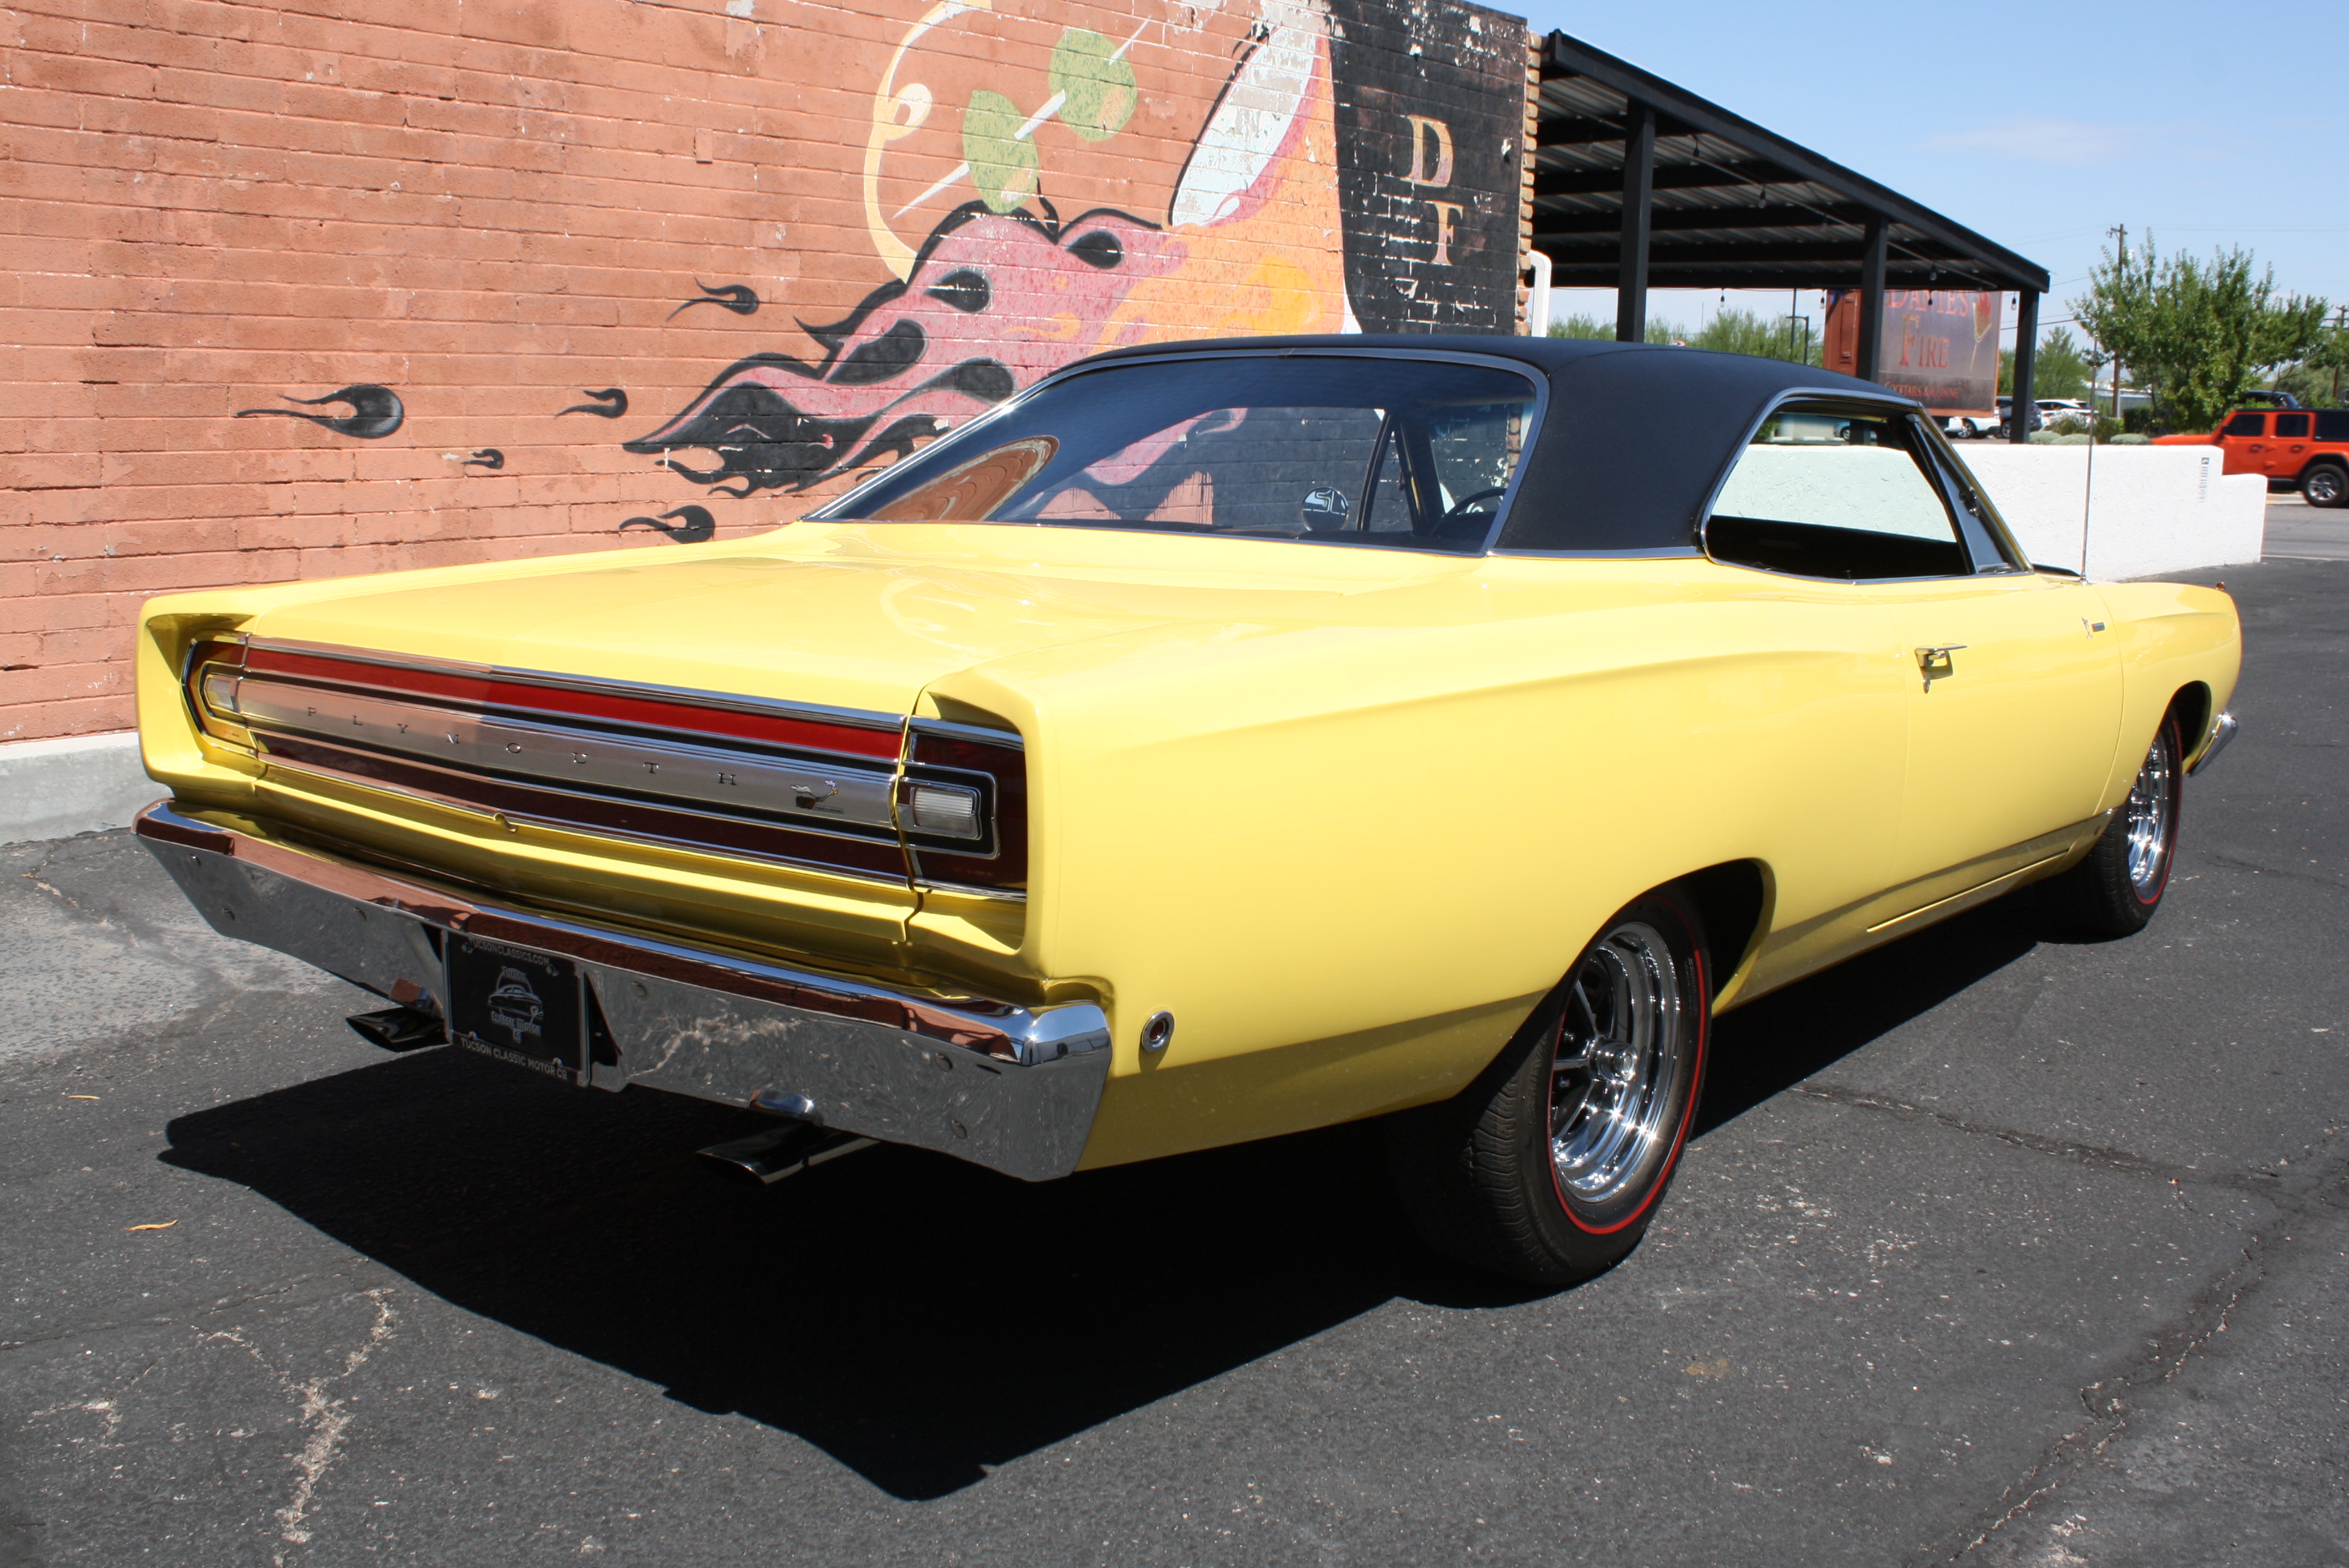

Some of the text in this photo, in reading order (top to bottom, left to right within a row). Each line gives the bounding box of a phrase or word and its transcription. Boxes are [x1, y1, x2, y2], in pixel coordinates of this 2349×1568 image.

[1400, 113, 1454, 188] D
[1428, 199, 1465, 266] F
[1899, 314, 1950, 369] FIRE
[306, 706, 738, 787] PLYMOUTH
[469, 938, 551, 967] TUCSONCLASSICS.COM
[460, 1037, 492, 1056] TUCSON
[493, 1048, 526, 1067] CLASSIC
[527, 1058, 556, 1076] MOTOR
